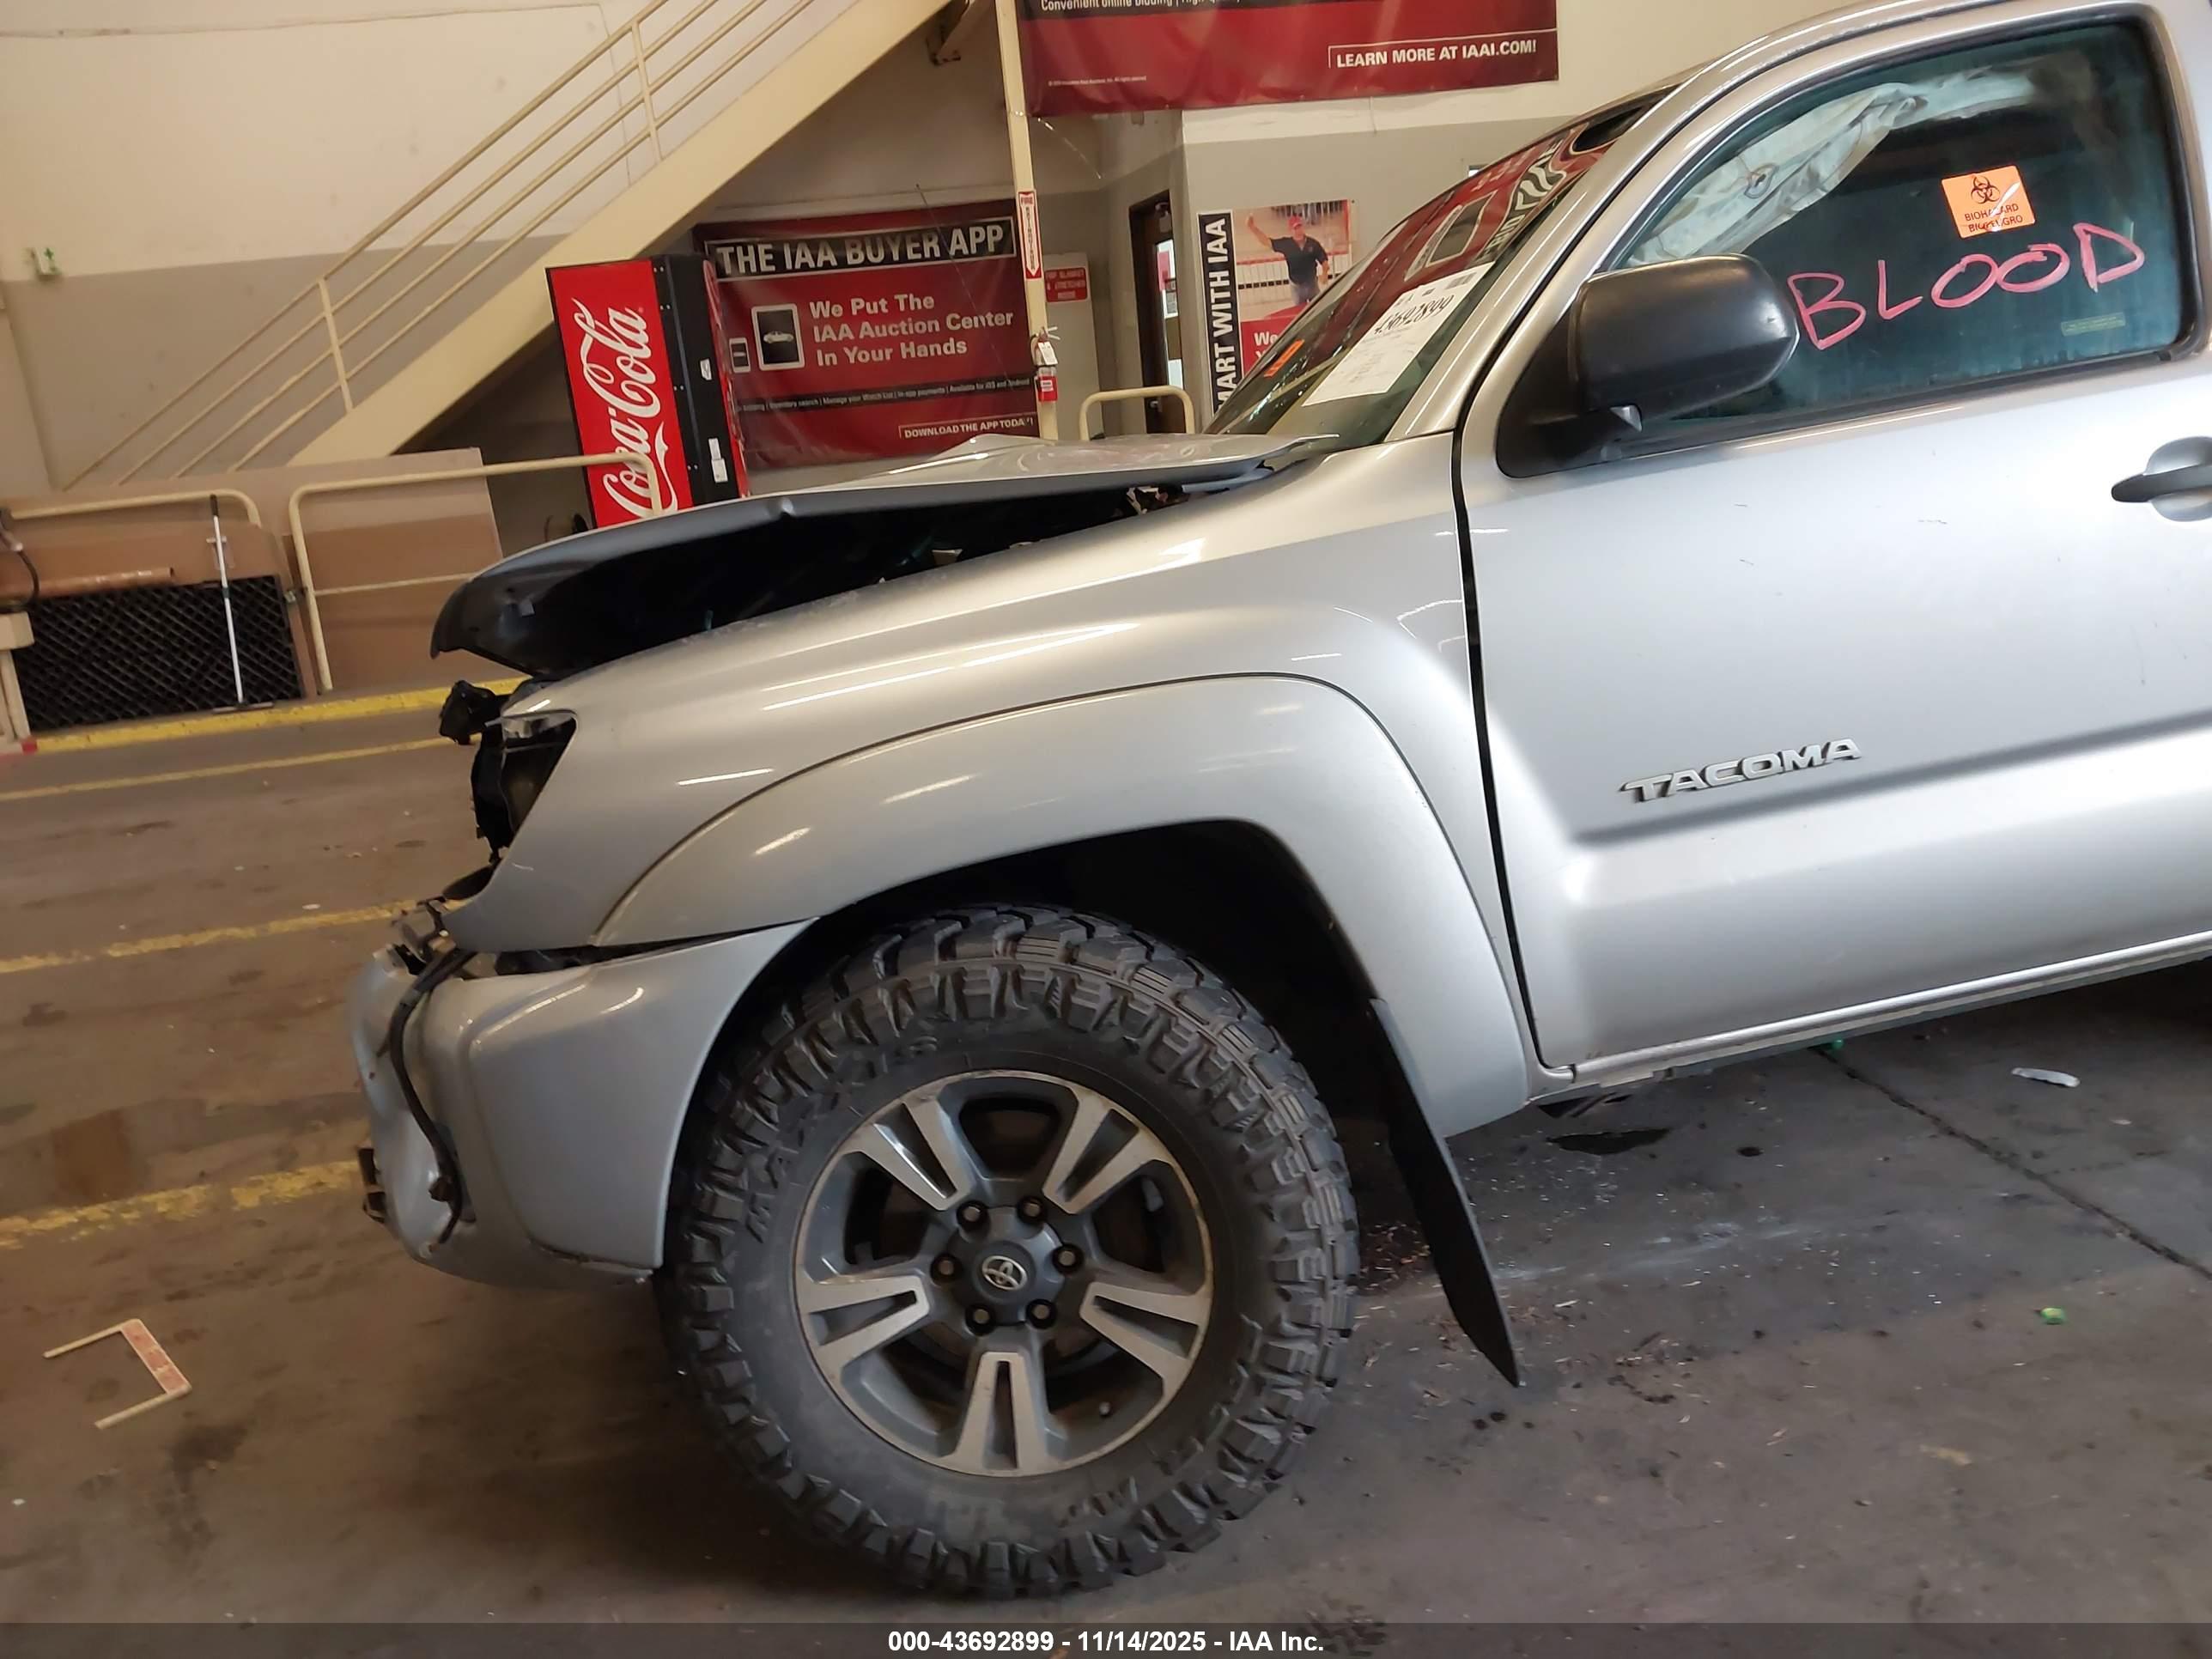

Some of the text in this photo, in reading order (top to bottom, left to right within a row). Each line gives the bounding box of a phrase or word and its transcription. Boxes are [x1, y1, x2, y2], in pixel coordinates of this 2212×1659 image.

[1336, 40, 1537, 68] LEARN MORE AT IAAI.COM!
[716, 243, 775, 276] THE
[783, 241, 838, 270] IAA
[845, 231, 940, 266] BUYER
[949, 224, 1004, 257] APP
[1205, 217, 1228, 264] IAA
[1208, 270, 1233, 337] WITH
[1787, 222, 2145, 350] BLOOD
[810, 293, 935, 319] We Put The
[813, 311, 1014, 343] IAA Auction Center
[816, 337, 968, 367] In Your Hands
[903, 423, 959, 439] DOWNLOAD
[960, 422, 978, 433] THE
[980, 420, 999, 430] APP
[1620, 738, 1863, 804] TACOMA
